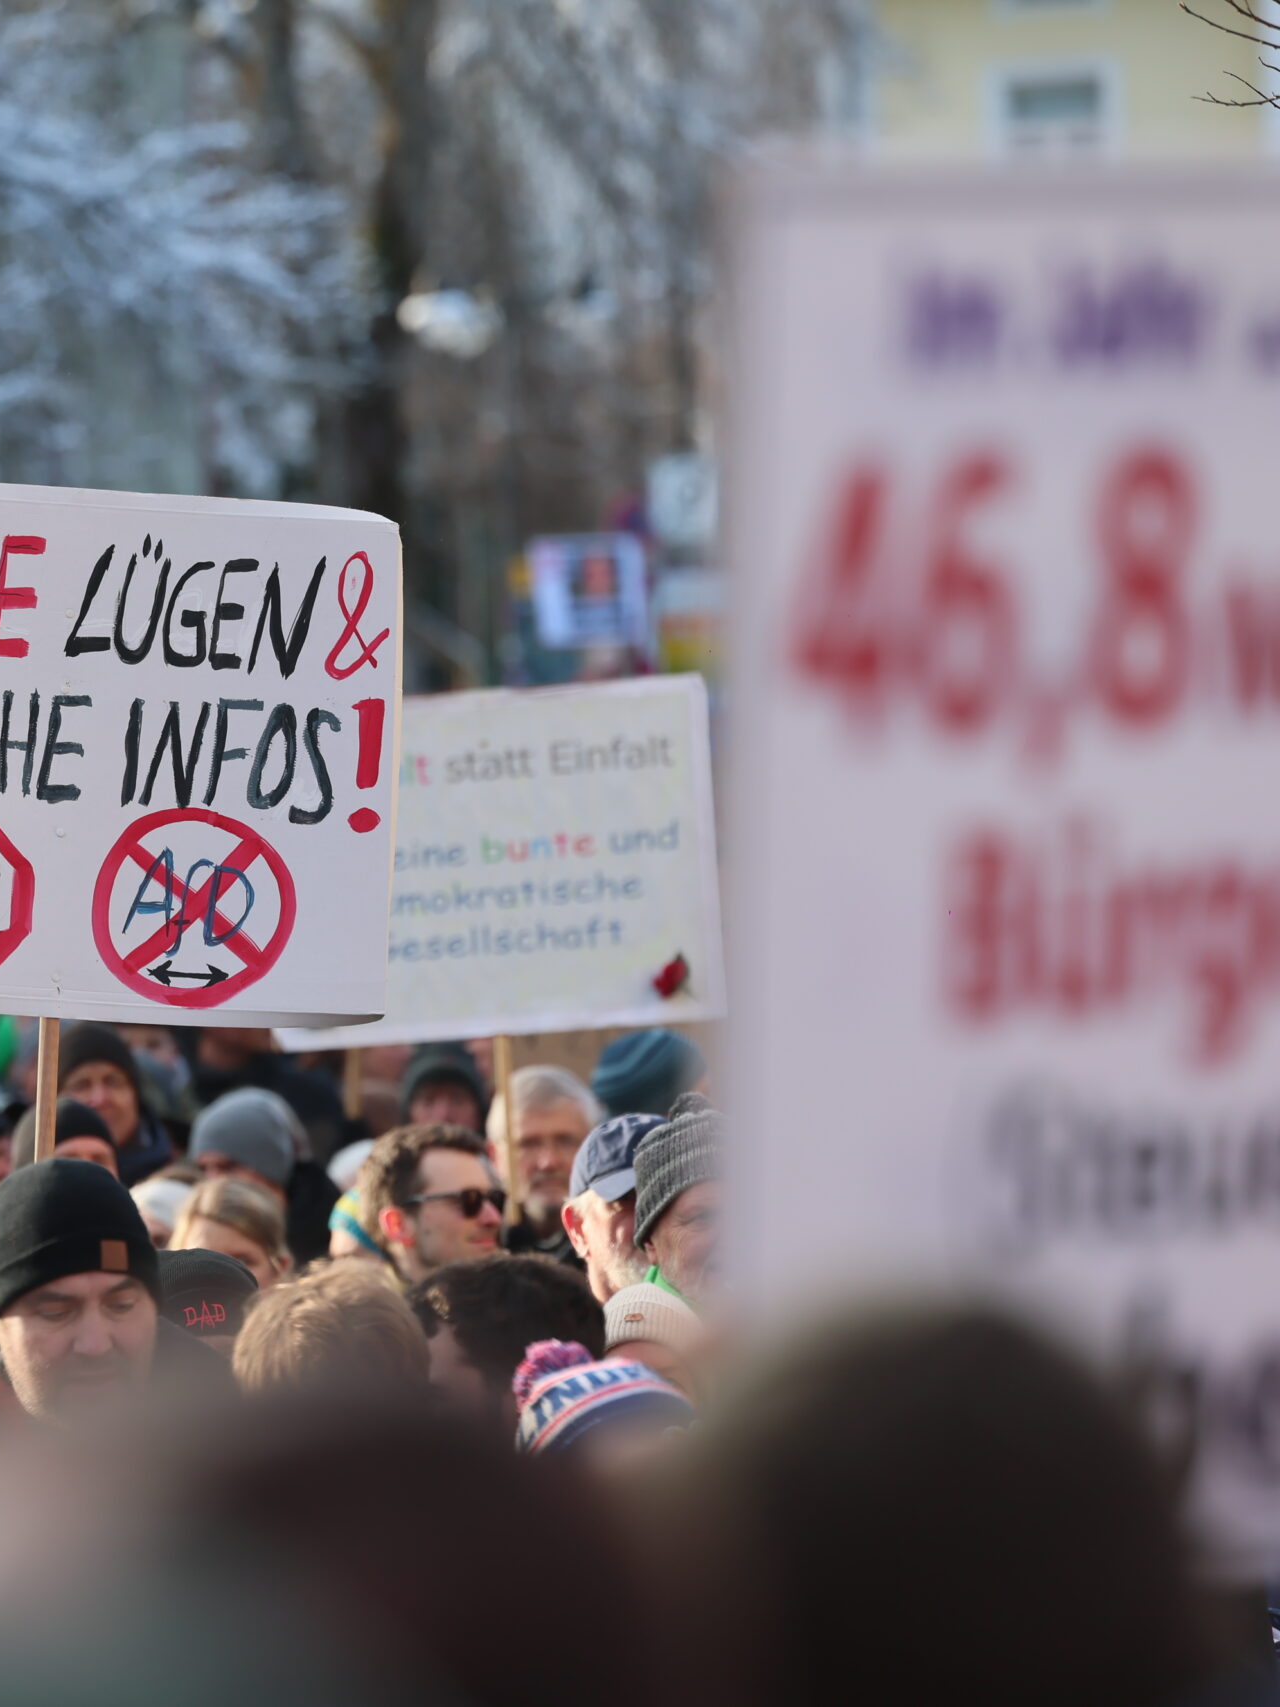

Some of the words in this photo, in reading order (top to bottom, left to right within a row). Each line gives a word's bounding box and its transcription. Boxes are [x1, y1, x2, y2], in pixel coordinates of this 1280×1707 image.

[63, 533, 326, 679] LÜGEN
[324, 550, 390, 680] &
[444, 745, 534, 784] statt
[549, 735, 675, 776] Einfalt
[480, 831, 596, 864] bunte
[608, 821, 680, 852] und
[183, 1299, 226, 1330] DAD
